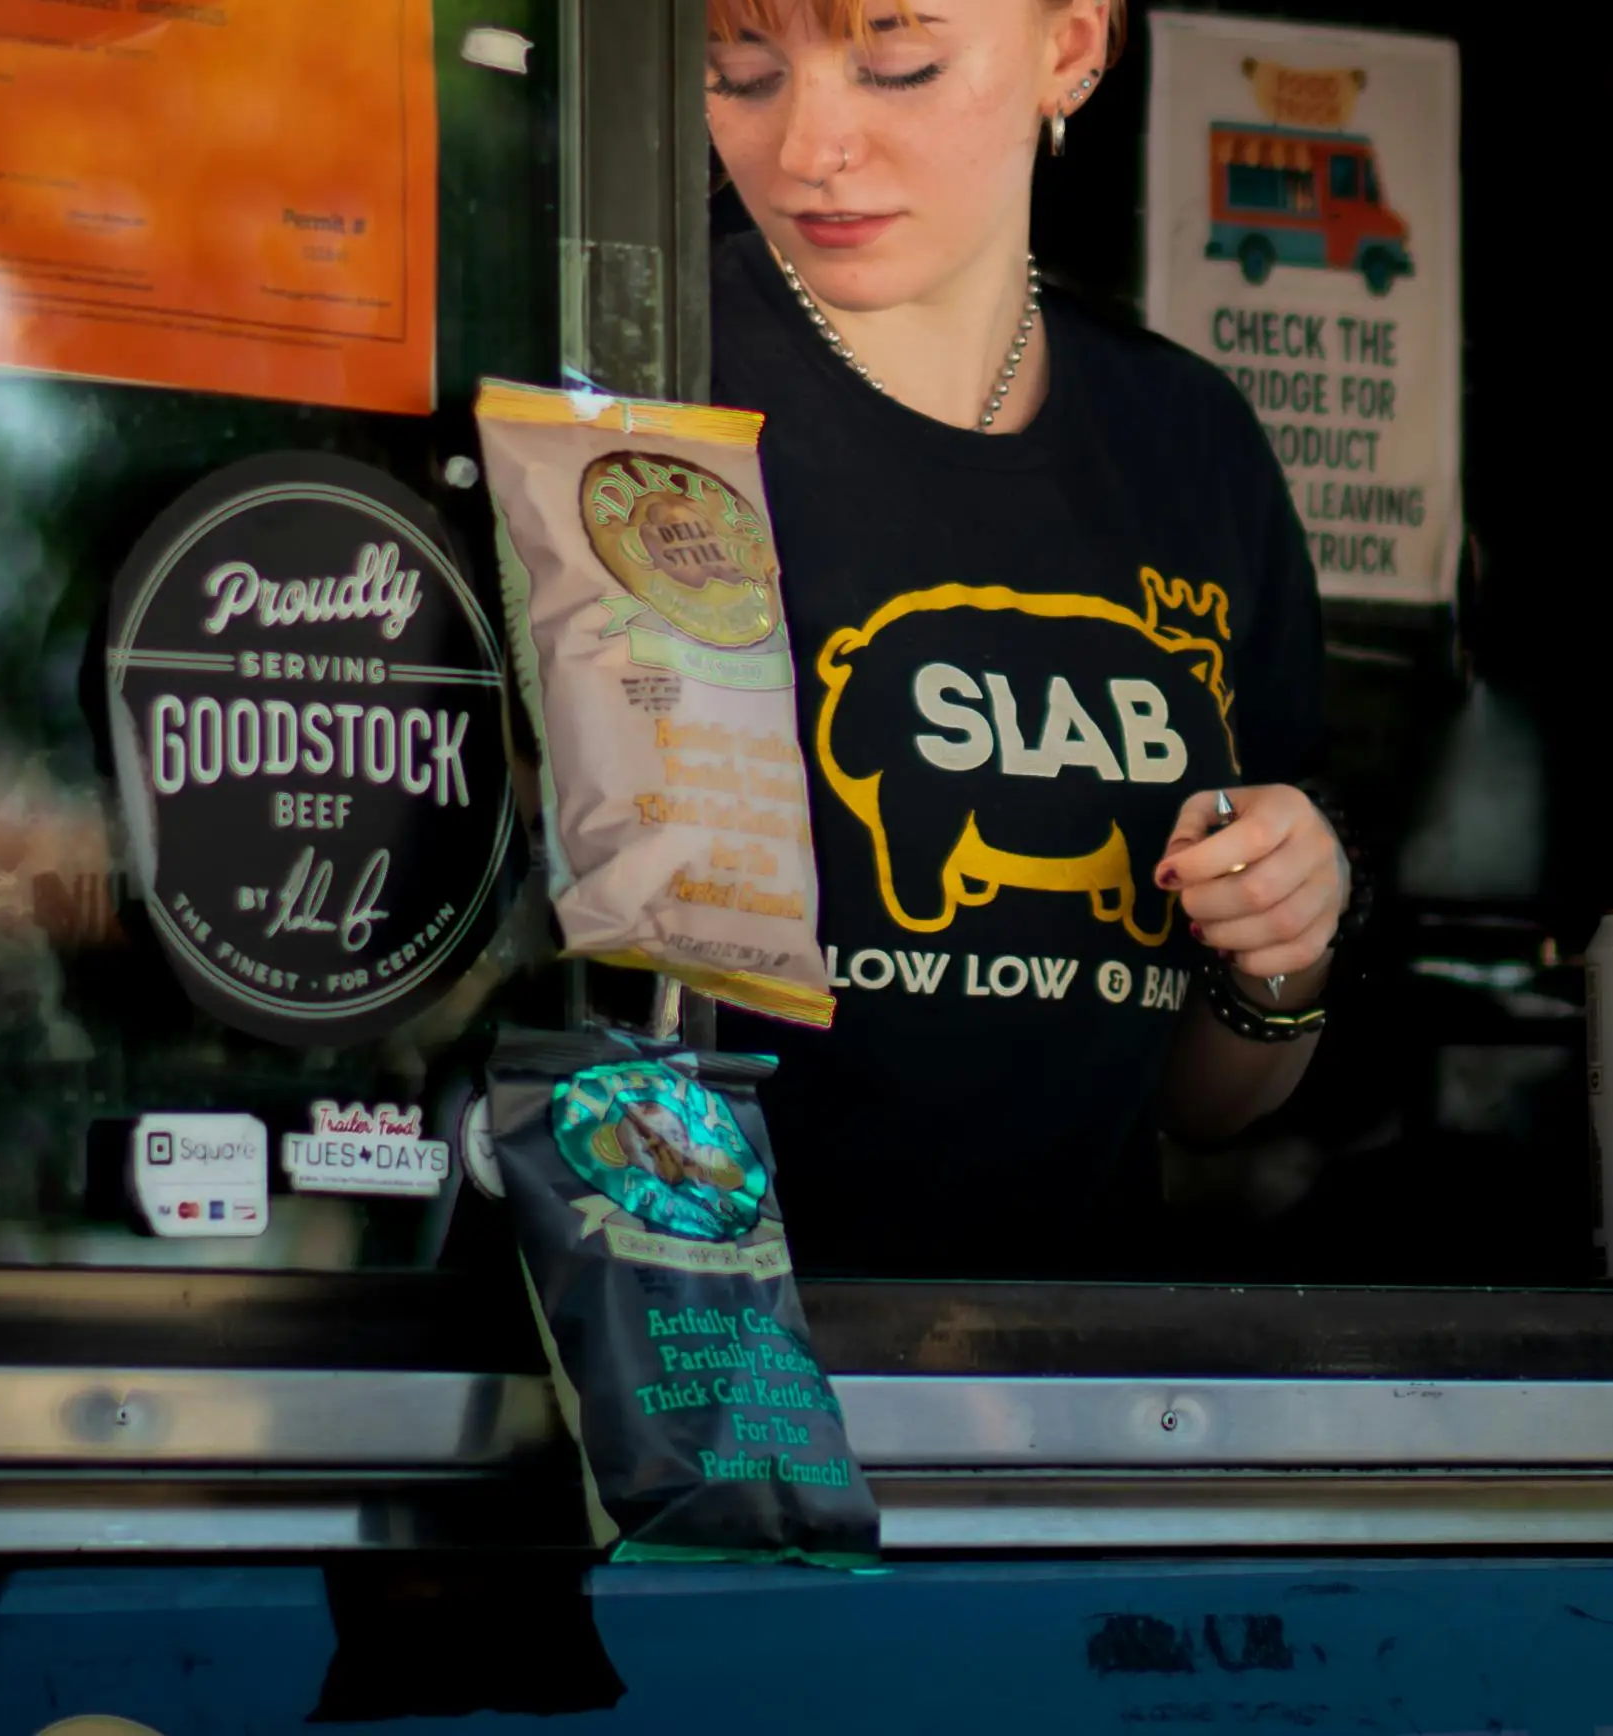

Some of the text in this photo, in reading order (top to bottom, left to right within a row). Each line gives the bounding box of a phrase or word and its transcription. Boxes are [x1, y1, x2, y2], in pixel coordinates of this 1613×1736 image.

[282, 207, 346, 234] Permit
[1212, 307, 1398, 367] CHECK THE
[1222, 365, 1396, 421] RIDGE FOR
[1306, 481, 1425, 529] LEAVING
[204, 542, 422, 640] Proudly
[240, 650, 386, 684] SERVING
[914, 663, 1189, 783] SLAB
[151, 694, 471, 808] GOODSTOCK
[275, 791, 354, 830] BEEF
[237, 885, 269, 911] BY
[172, 892, 214, 944] THE
[216, 941, 300, 992] FINEST
[327, 968, 370, 994] FOR
[377, 901, 457, 978] CERTAIN
[826, 944, 951, 996] LOW
[965, 953, 1080, 1001] LOW
[1098, 959, 1133, 1005] &
[318, 1107, 419, 1137] Trailer Food
[179, 1136, 256, 1165] Square
[646, 1307, 740, 1340] Artfully
[658, 1343, 759, 1377] Partially
[635, 1382, 711, 1416] Thick
[712, 1377, 752, 1407] Cut
[752, 1378, 813, 1410] Kettle
[732, 1412, 810, 1446] For The
[698, 1450, 851, 1487] Perfect Crunch!
